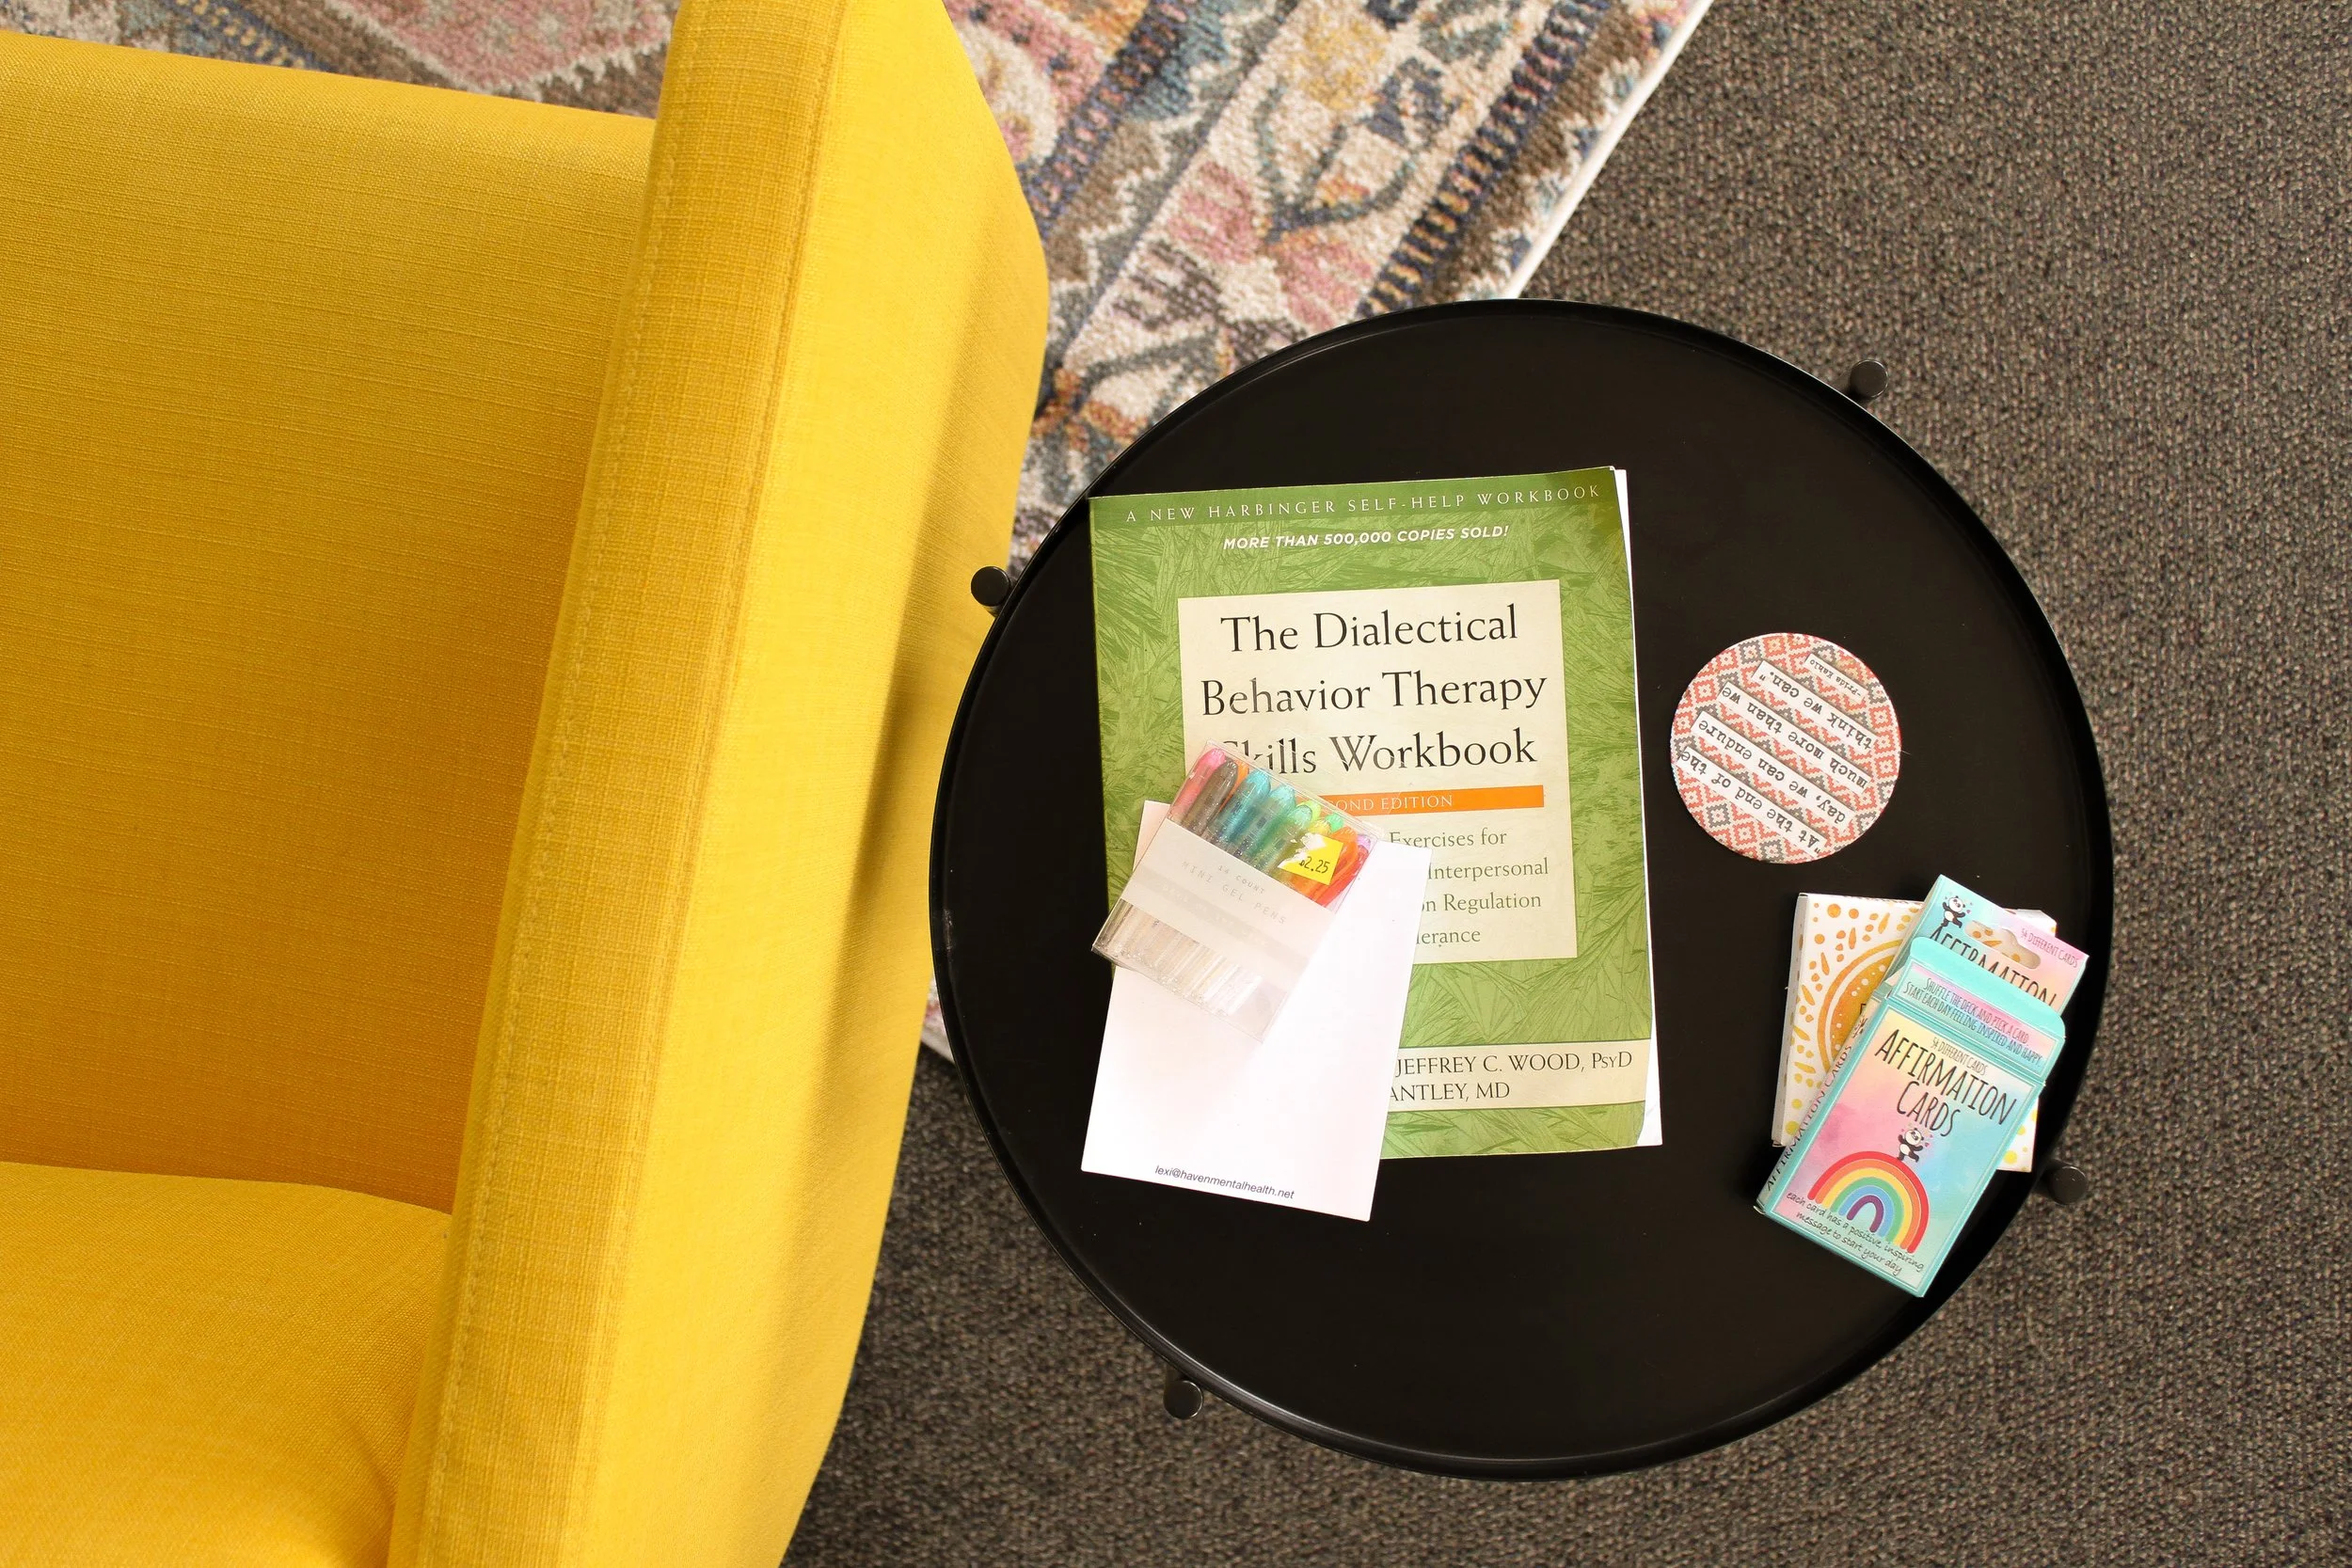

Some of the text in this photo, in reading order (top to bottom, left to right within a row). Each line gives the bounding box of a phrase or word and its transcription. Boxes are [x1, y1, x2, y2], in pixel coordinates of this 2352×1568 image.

[1126, 484, 1599, 522] A NEW HARBINGER SELF-HELP WORKBOOK
[1223, 525, 1509, 550] MORE THAN 500,000 COPIES SOLD!
[1221, 603, 1518, 653] The Dialectical
[1809, 659, 1834, 678] Kahlo
[1201, 671, 1547, 716] Behavior Therapy
[1804, 697, 1821, 714] we
[1722, 687, 1867, 788] much more than we
[1826, 712, 1871, 749] think
[1329, 728, 1537, 772] Workbook
[1680, 750, 1707, 774] the
[1698, 720, 1845, 823] day, we can endure
[1710, 772, 1730, 787] of
[1381, 795, 1454, 810] EDITION
[1735, 786, 1761, 809] end
[1390, 827, 1507, 847] Exercises for
[1767, 808, 1792, 832] the
[1235, 874, 1265, 895] COUNT
[1428, 857, 1549, 881] Interpersonal
[1222, 883, 1245, 902] GEL
[1253, 901, 1286, 925] PENS
[1444, 892, 1541, 914] Regulation
[1417, 929, 1481, 944] lerance
[2027, 932, 2058, 956] DIFFERENT
[2058, 949, 2079, 967] CARDS
[1922, 977, 1950, 1001] SHUFFLE
[1947, 992, 1963, 1007] THE
[1960, 999, 1977, 1014] DECK
[1976, 1008, 1992, 1022] AND
[1902, 981, 1925, 1000] START
[1921, 992, 1939, 1008] EACH
[1937, 1001, 1952, 1015] DAY
[1949, 1008, 1978, 1030] FEELING
[1976, 1022, 2007, 1046] INSPIRED
[2005, 1039, 2022, 1054] AND
[1395, 1056, 1476, 1078] JEFFREY
[1483, 1054, 1502, 1072] C.
[1508, 1053, 1585, 1072] WOOD,
[1937, 1041, 1970, 1064] DIFFERENT
[1966, 1057, 1987, 1075] CARDS
[1390, 1082, 1510, 1102] ANTLEY, MD
[1874, 1029, 2016, 1124] AFFIRMATION
[1767, 1044, 1851, 1191] AFFIRMATION CARDS
[1897, 1081, 1960, 1136] CARDS
[1154, 1164, 1295, 1199] lexi@havenmentalhealth.net
[1787, 1192, 1804, 1205] each
[1806, 1201, 1826, 1215] card
[1826, 1212, 1842, 1225] has
[1849, 1226, 1882, 1248] positive,
[1883, 1242, 1923, 1272] inspiring
[1796, 1212, 1832, 1234] message
[1841, 1237, 1862, 1250] start
[1861, 1248, 1883, 1263] your
[1884, 1259, 1901, 1275] day
